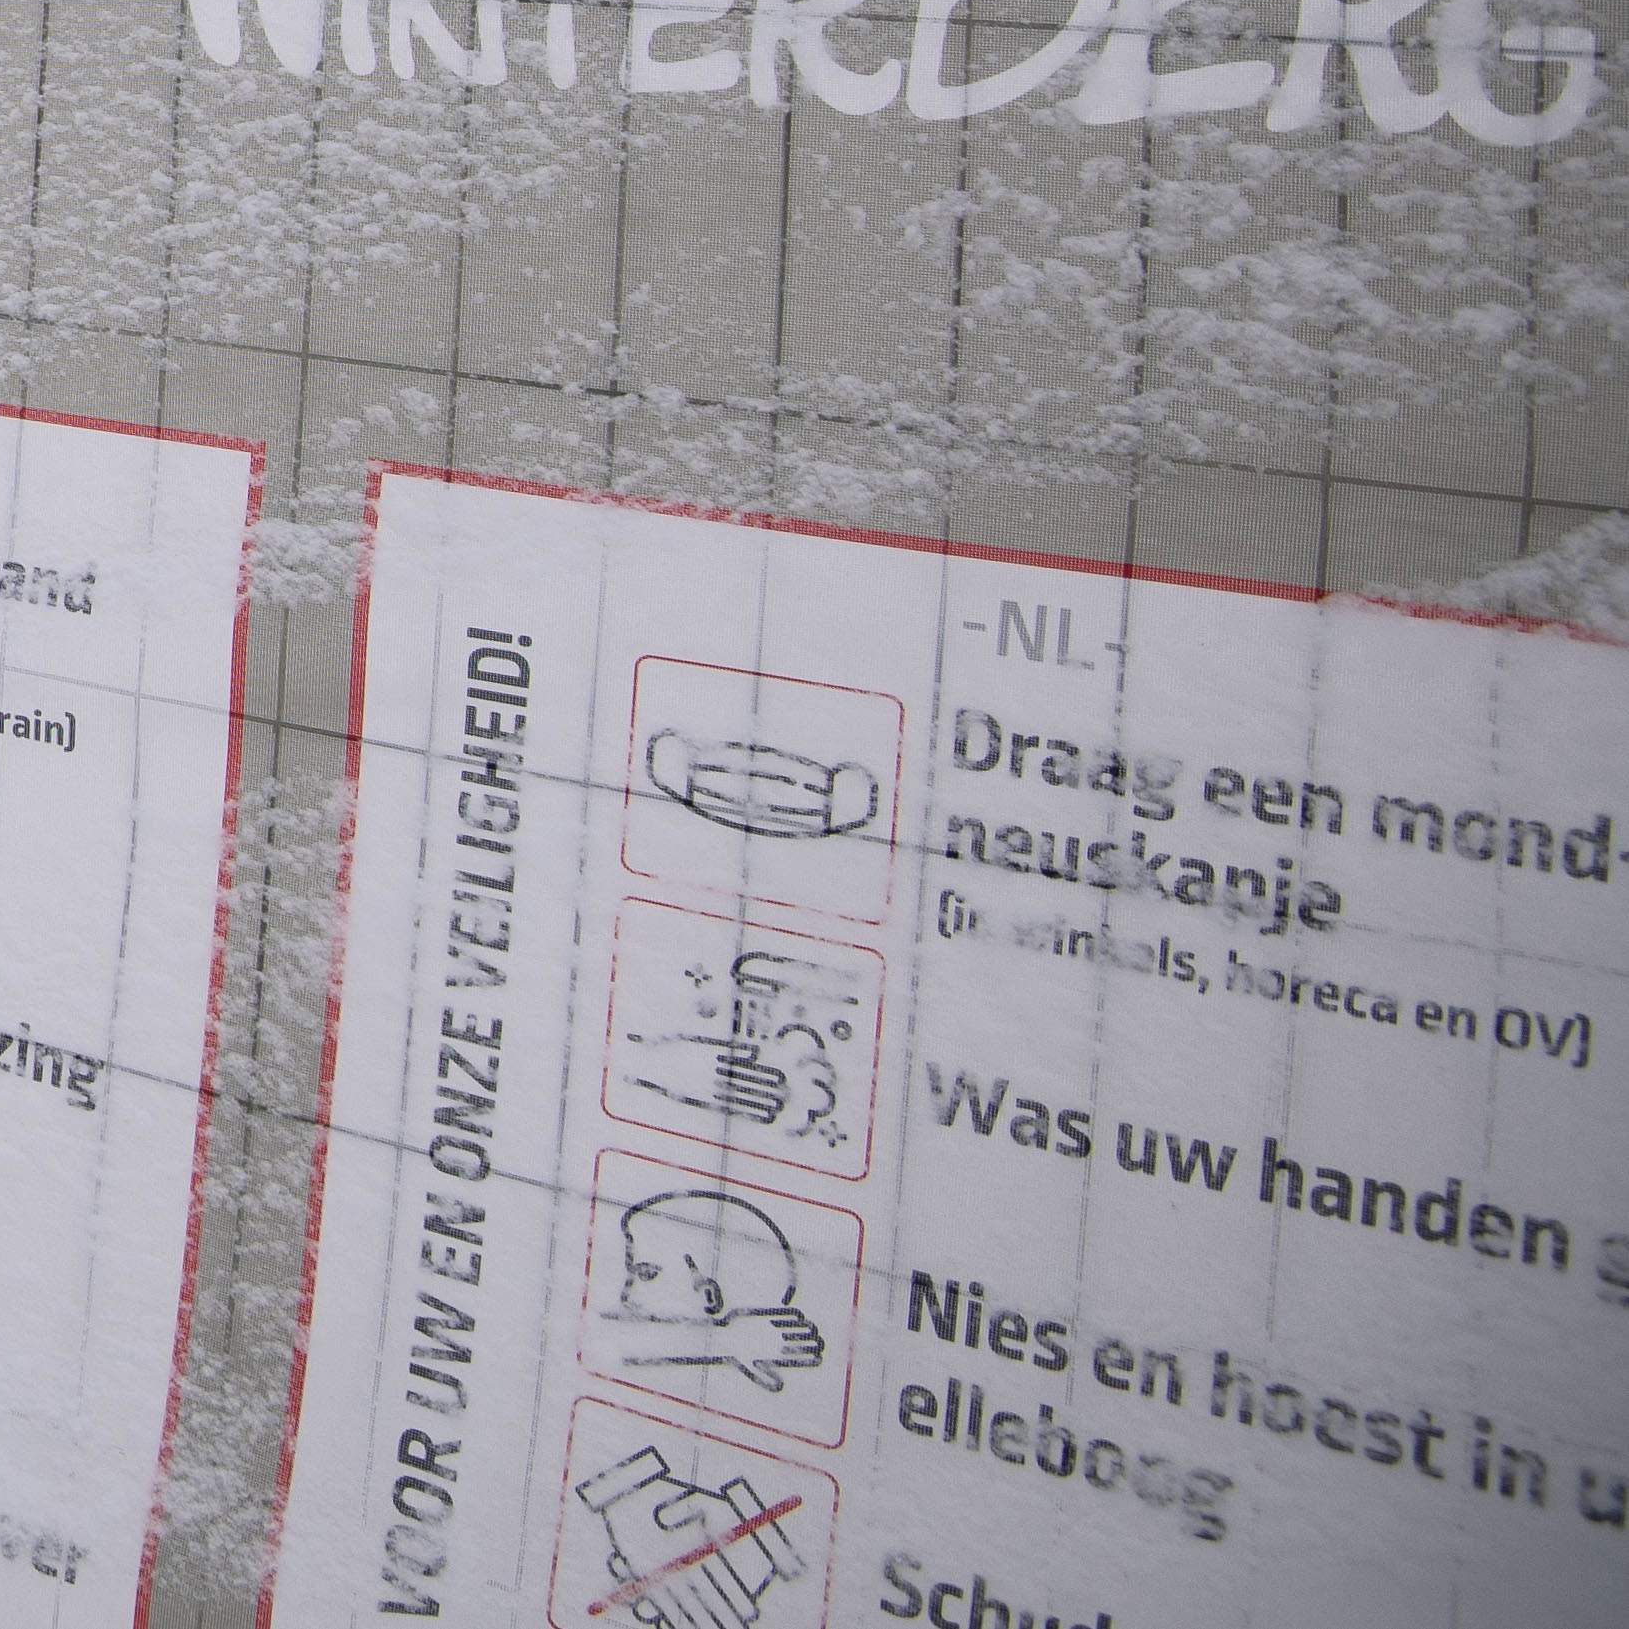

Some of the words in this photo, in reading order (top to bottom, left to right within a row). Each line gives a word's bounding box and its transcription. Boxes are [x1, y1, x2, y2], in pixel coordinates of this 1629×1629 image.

[962, 600, 1131, 672] -NL-
[445, 627, 534, 989] VEILIGHEID!
[952, 708, 1185, 822] Draag
[1203, 765, 1347, 836] een
[1416, 999, 1478, 1042] en
[428, 1006, 504, 1183] ONZE
[927, 1060, 1093, 1160] Was
[1115, 1122, 1240, 1193] uw
[1259, 1135, 1571, 1272] handen
[419, 1190, 487, 1288] EN
[404, 1290, 477, 1414] UW
[906, 1268, 1071, 1374] Nies
[1093, 1335, 1185, 1408] en
[1471, 1413, 1550, 1510] in
